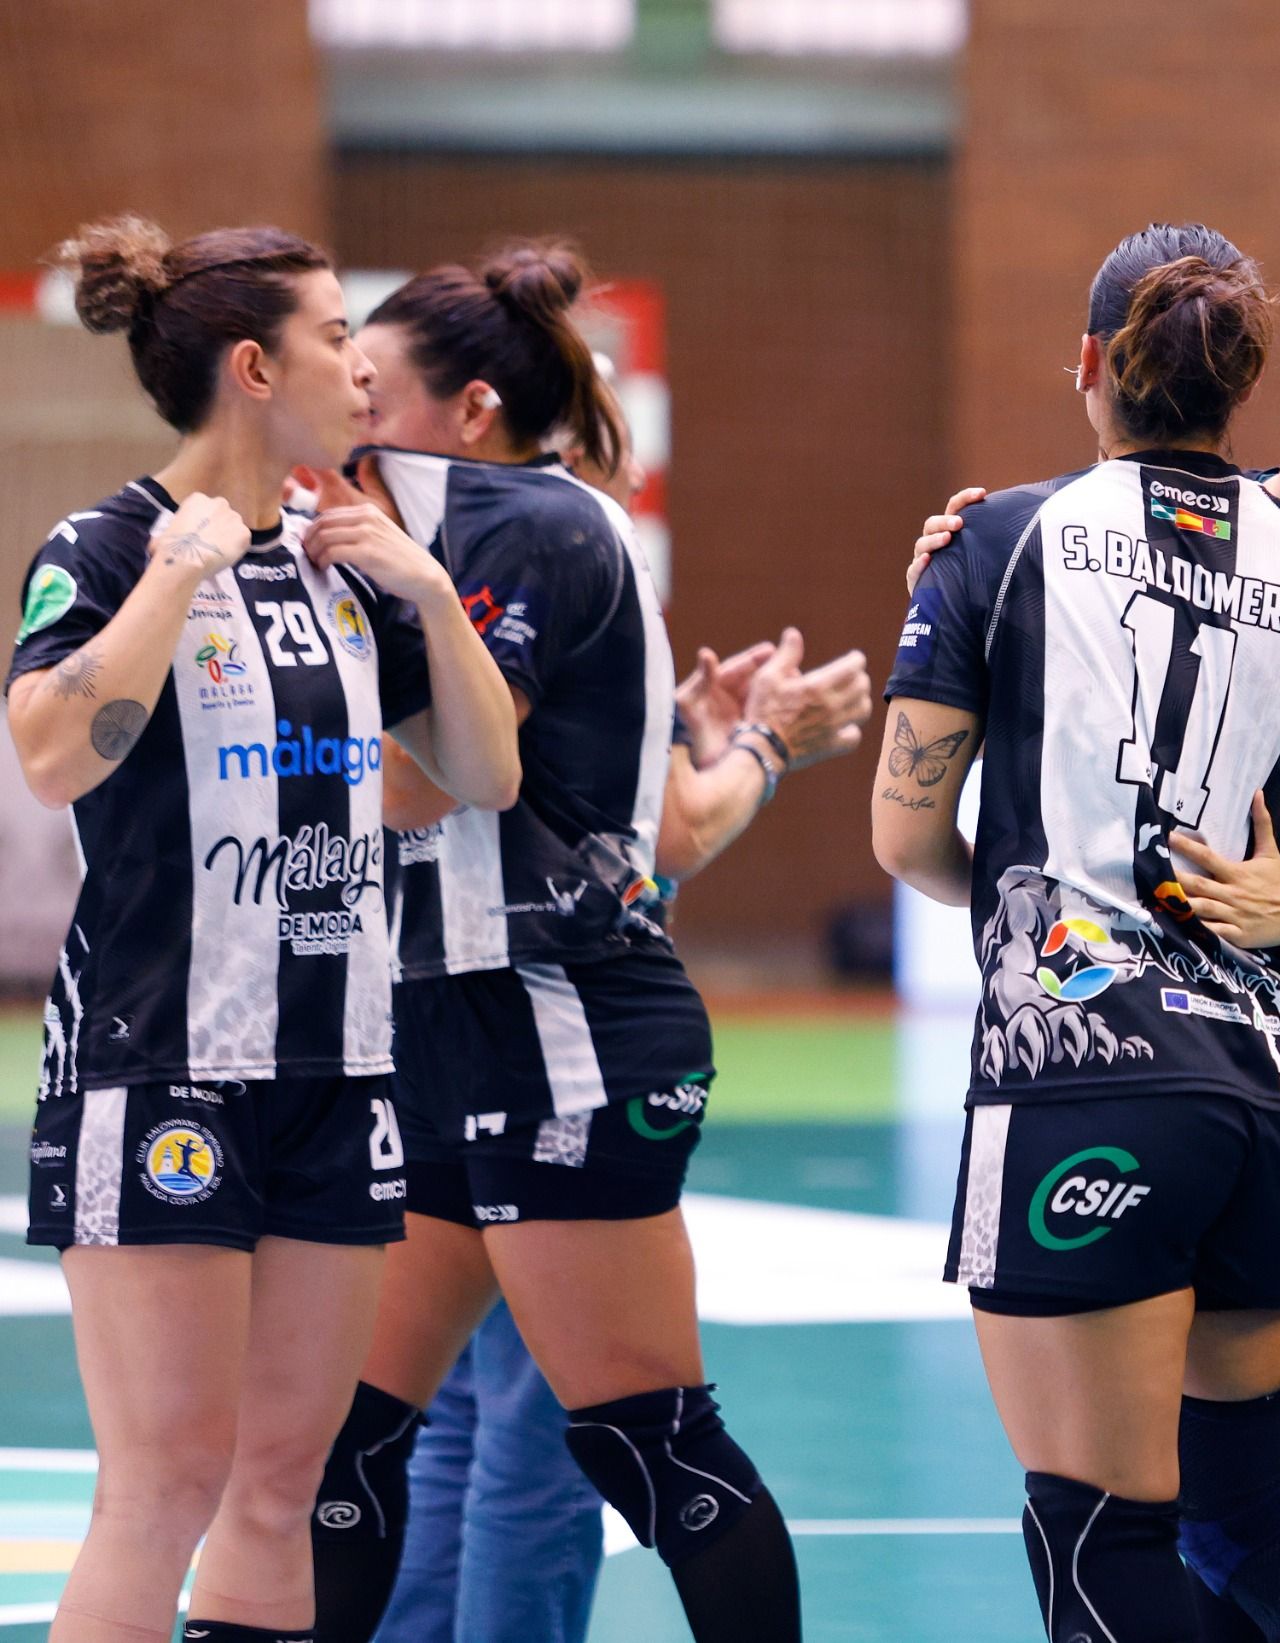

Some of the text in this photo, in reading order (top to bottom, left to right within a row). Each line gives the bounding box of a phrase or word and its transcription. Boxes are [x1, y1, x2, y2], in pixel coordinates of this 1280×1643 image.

[1150, 480, 1212, 510] emec
[1062, 525, 1101, 572] S.
[255, 600, 329, 667] 29
[1115, 588, 1239, 831] 11
[279, 912, 364, 937] DE MODA
[169, 1085, 190, 1099] DE
[1051, 1175, 1152, 1219] CSIF
